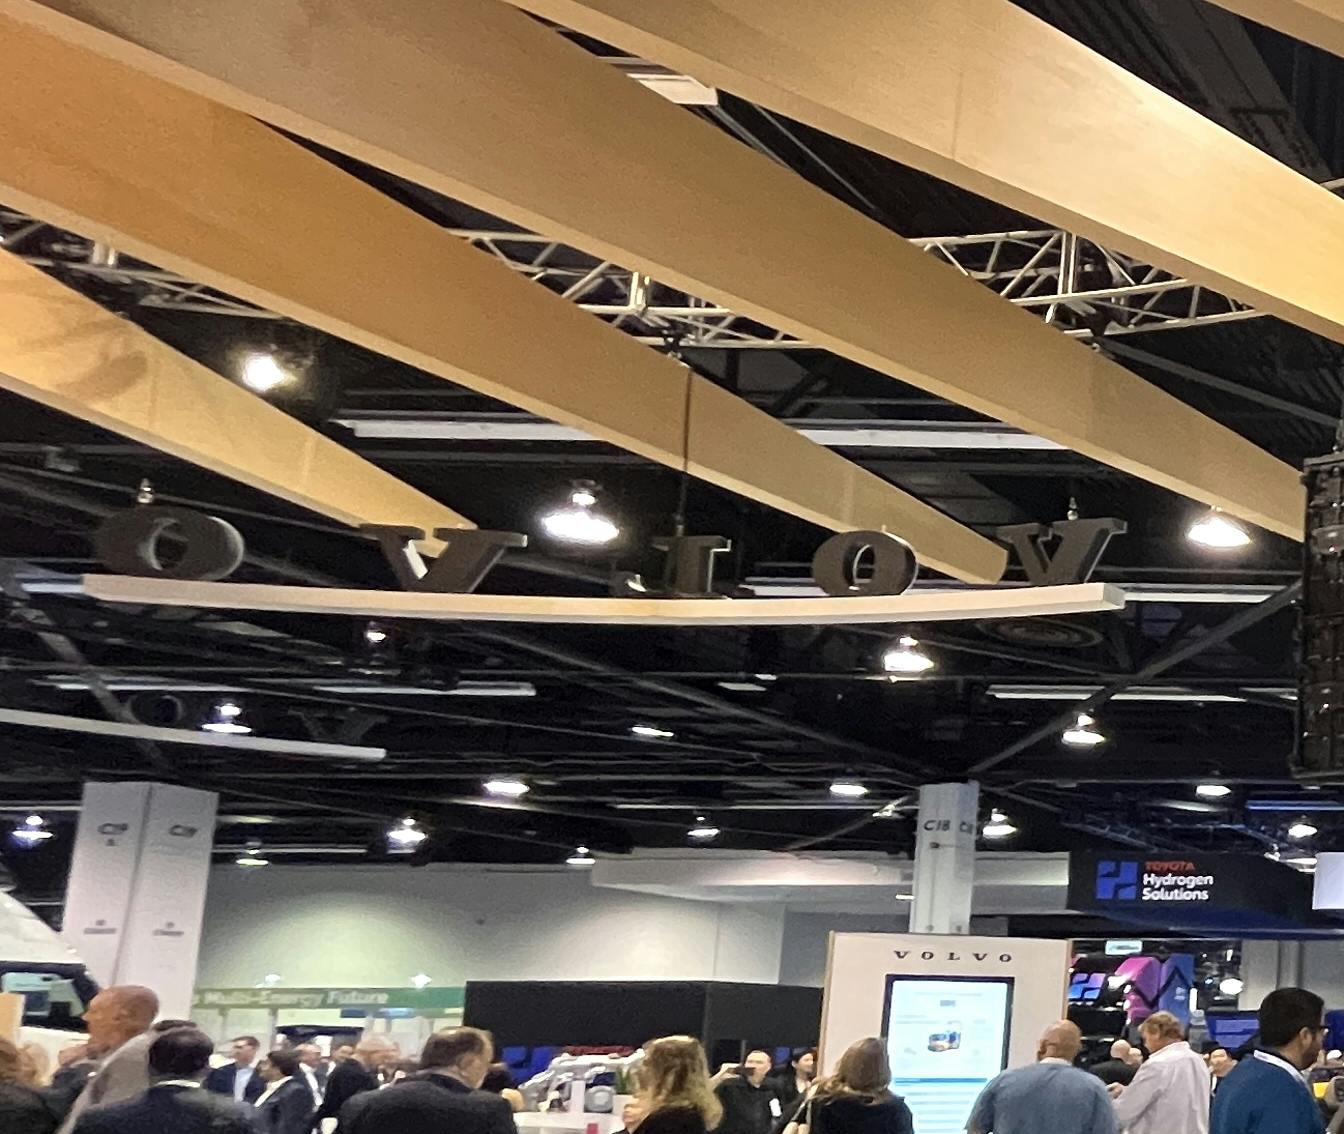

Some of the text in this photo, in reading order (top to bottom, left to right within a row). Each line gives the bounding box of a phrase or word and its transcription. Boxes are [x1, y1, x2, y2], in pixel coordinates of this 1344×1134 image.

[1145, 861, 1196, 871] TOYOTA
[1142, 873, 1214, 888] Hydrogen
[1142, 887, 1209, 901] Solutions
[894, 950, 1012, 963] VOLVO
[327, 990, 389, 1005] Future
